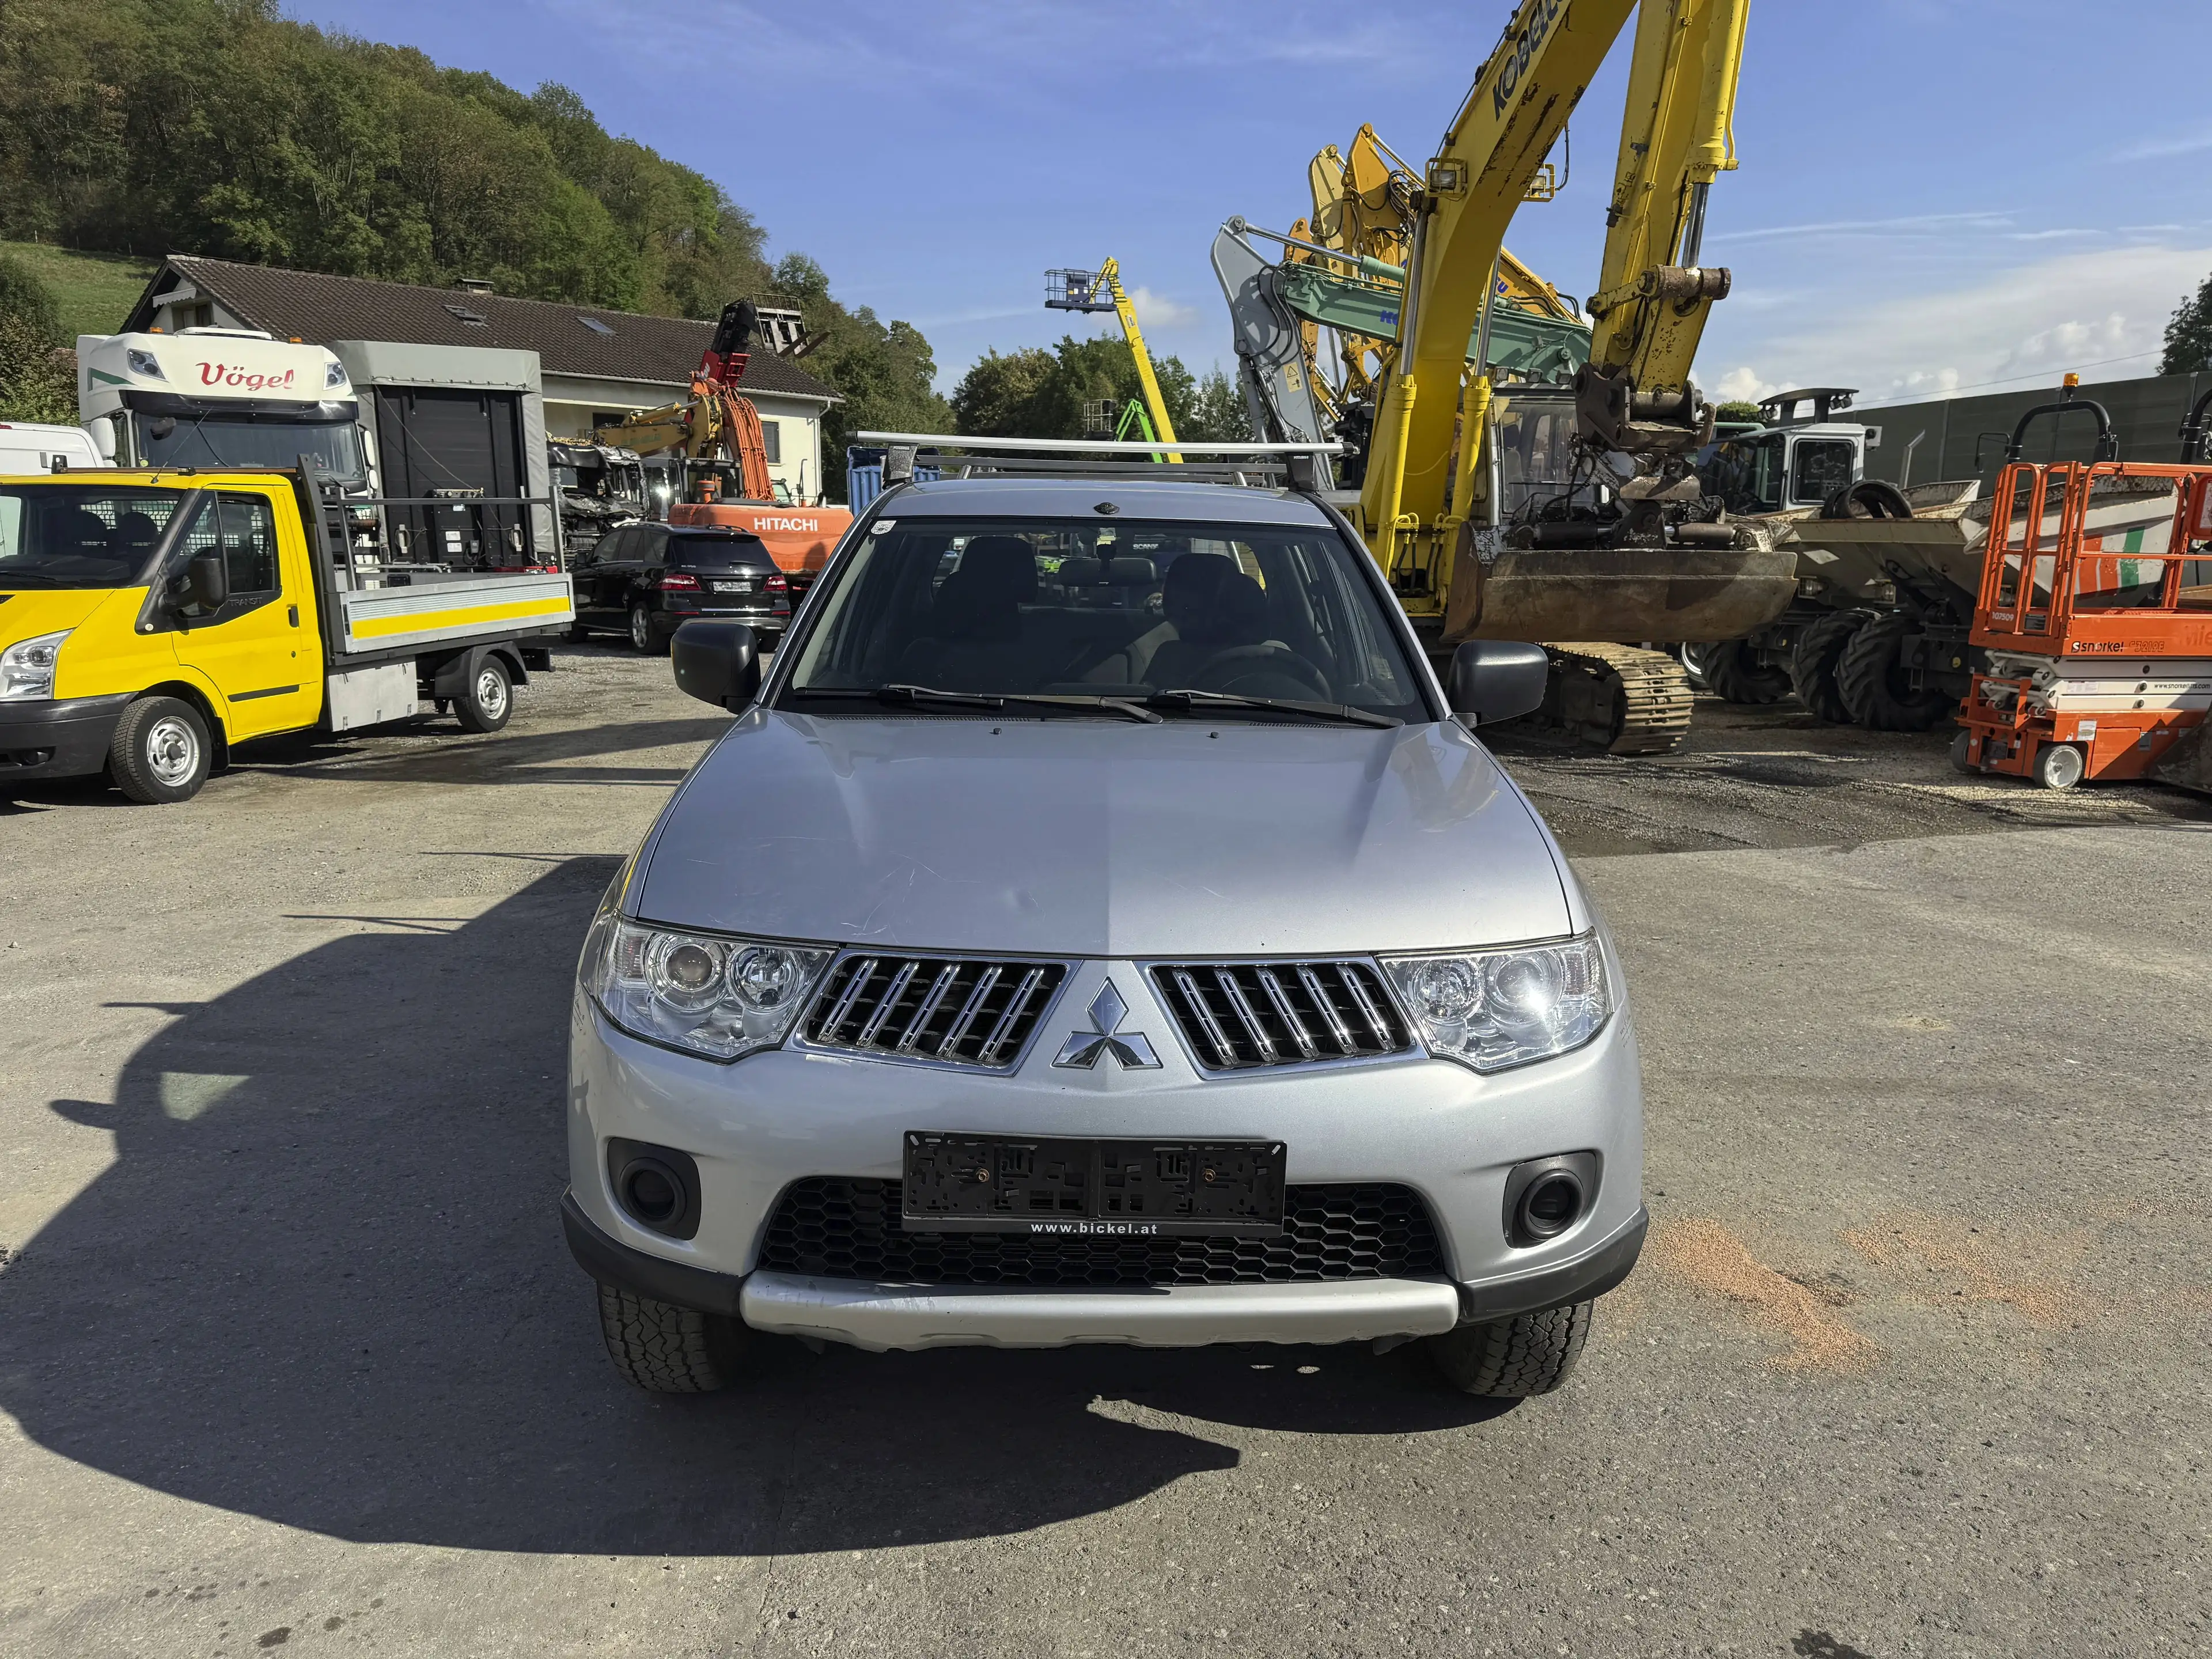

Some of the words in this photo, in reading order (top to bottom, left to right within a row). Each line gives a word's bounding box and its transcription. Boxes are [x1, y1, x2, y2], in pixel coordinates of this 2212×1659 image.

[195, 362, 294, 391] Vögel
[753, 517, 818, 532] HITACHI
[229, 597, 263, 607] TRANSIT
[1992, 612, 2014, 621] 107509
[1031, 1222, 1157, 1234] www.bickel.at
